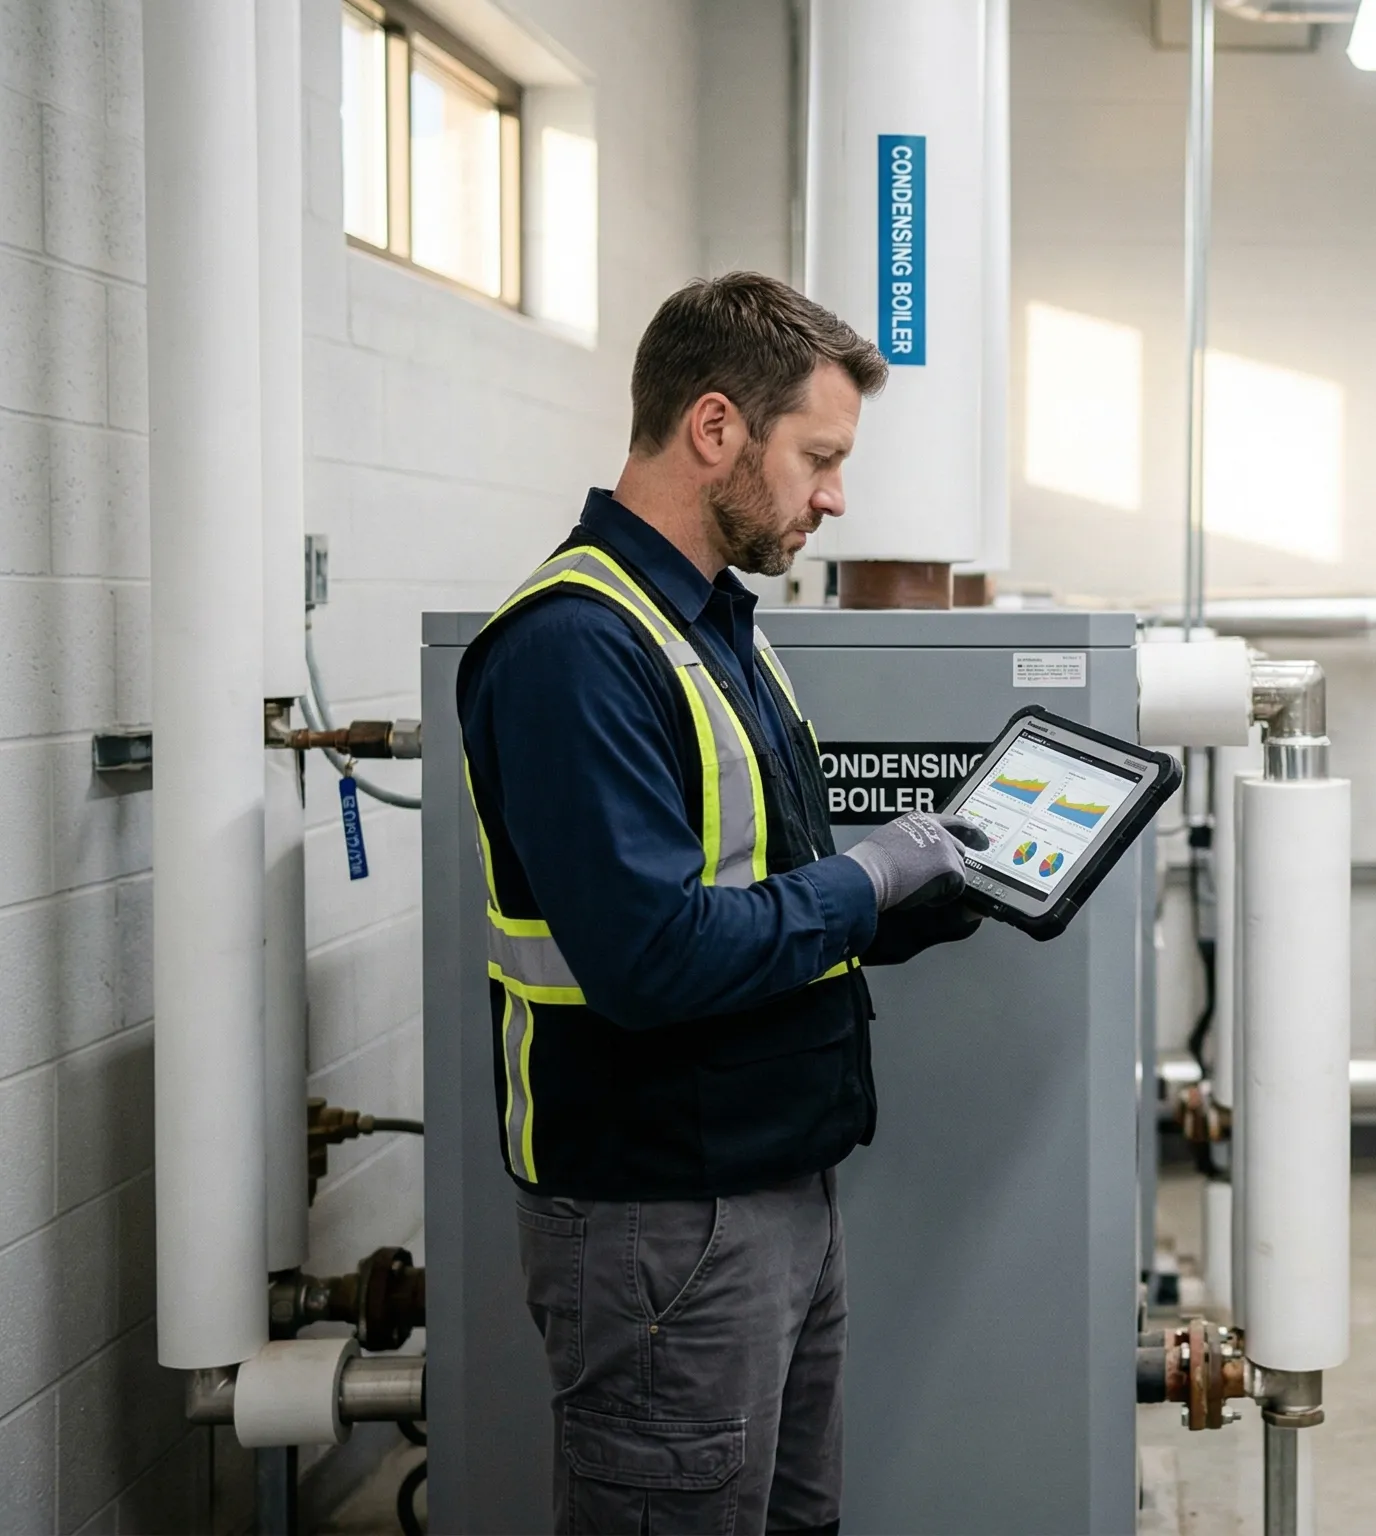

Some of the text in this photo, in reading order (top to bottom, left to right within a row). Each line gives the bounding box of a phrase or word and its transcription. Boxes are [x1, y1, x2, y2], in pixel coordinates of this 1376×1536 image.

[892, 146, 913, 354] CONDENSING BOILER
[820, 753, 984, 778] ONDENSIN
[828, 787, 935, 812] BOILER
